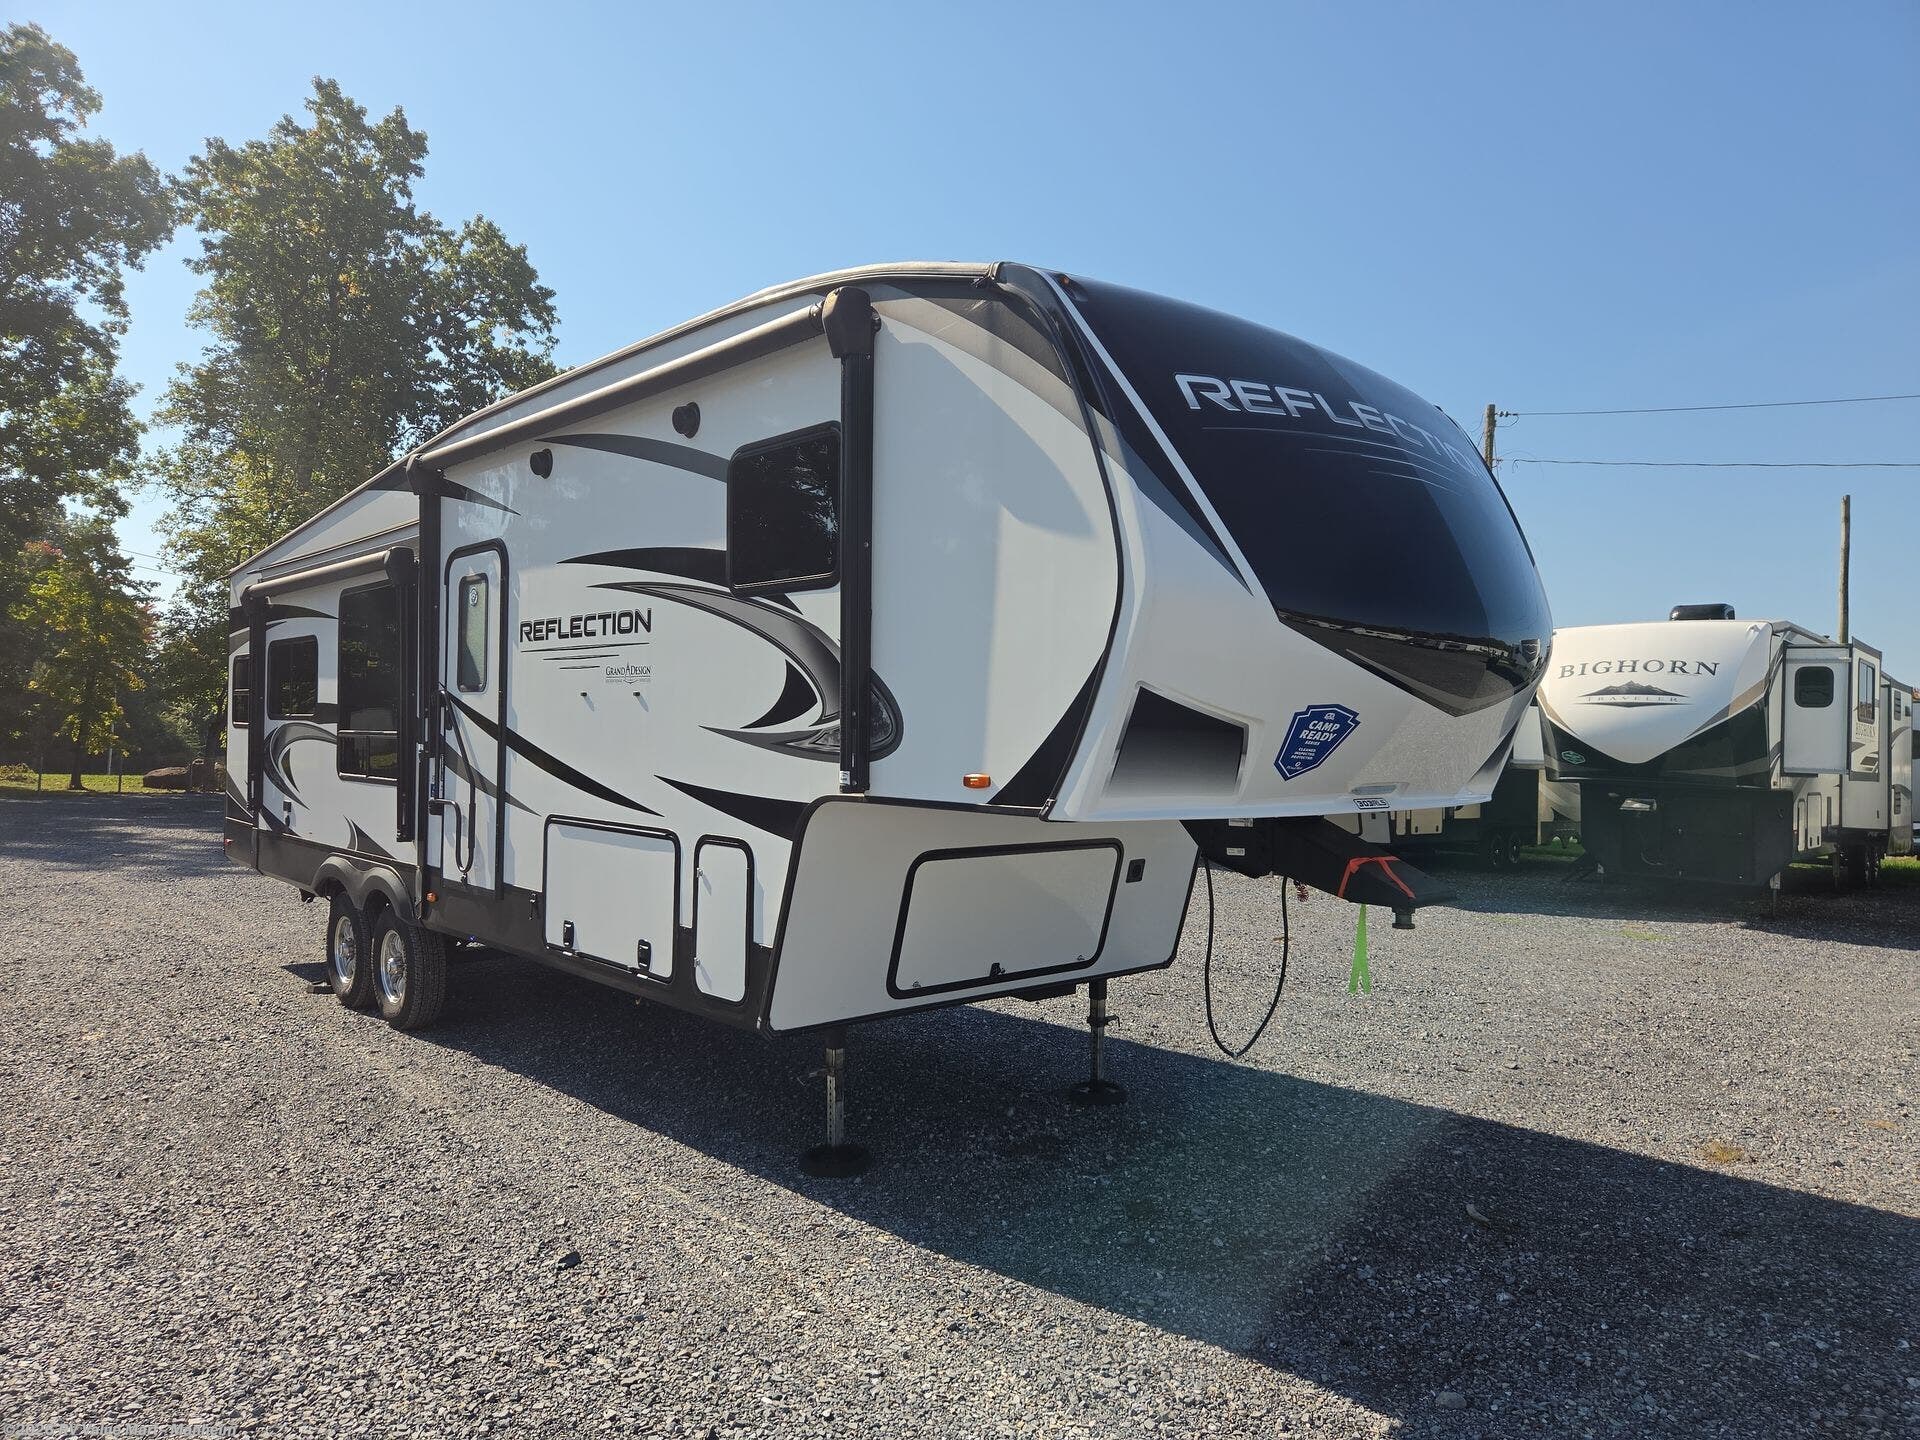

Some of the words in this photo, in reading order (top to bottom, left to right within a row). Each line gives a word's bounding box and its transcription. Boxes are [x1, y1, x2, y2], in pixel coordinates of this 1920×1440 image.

[520, 608, 652, 643] REFLECTION
[605, 666, 626, 676] GRAND
[630, 665, 652, 675] DESIGN
[1558, 659, 1720, 679] BIGHORN
[1309, 720, 1340, 732] CAMP
[1299, 730, 1337, 741] READY
